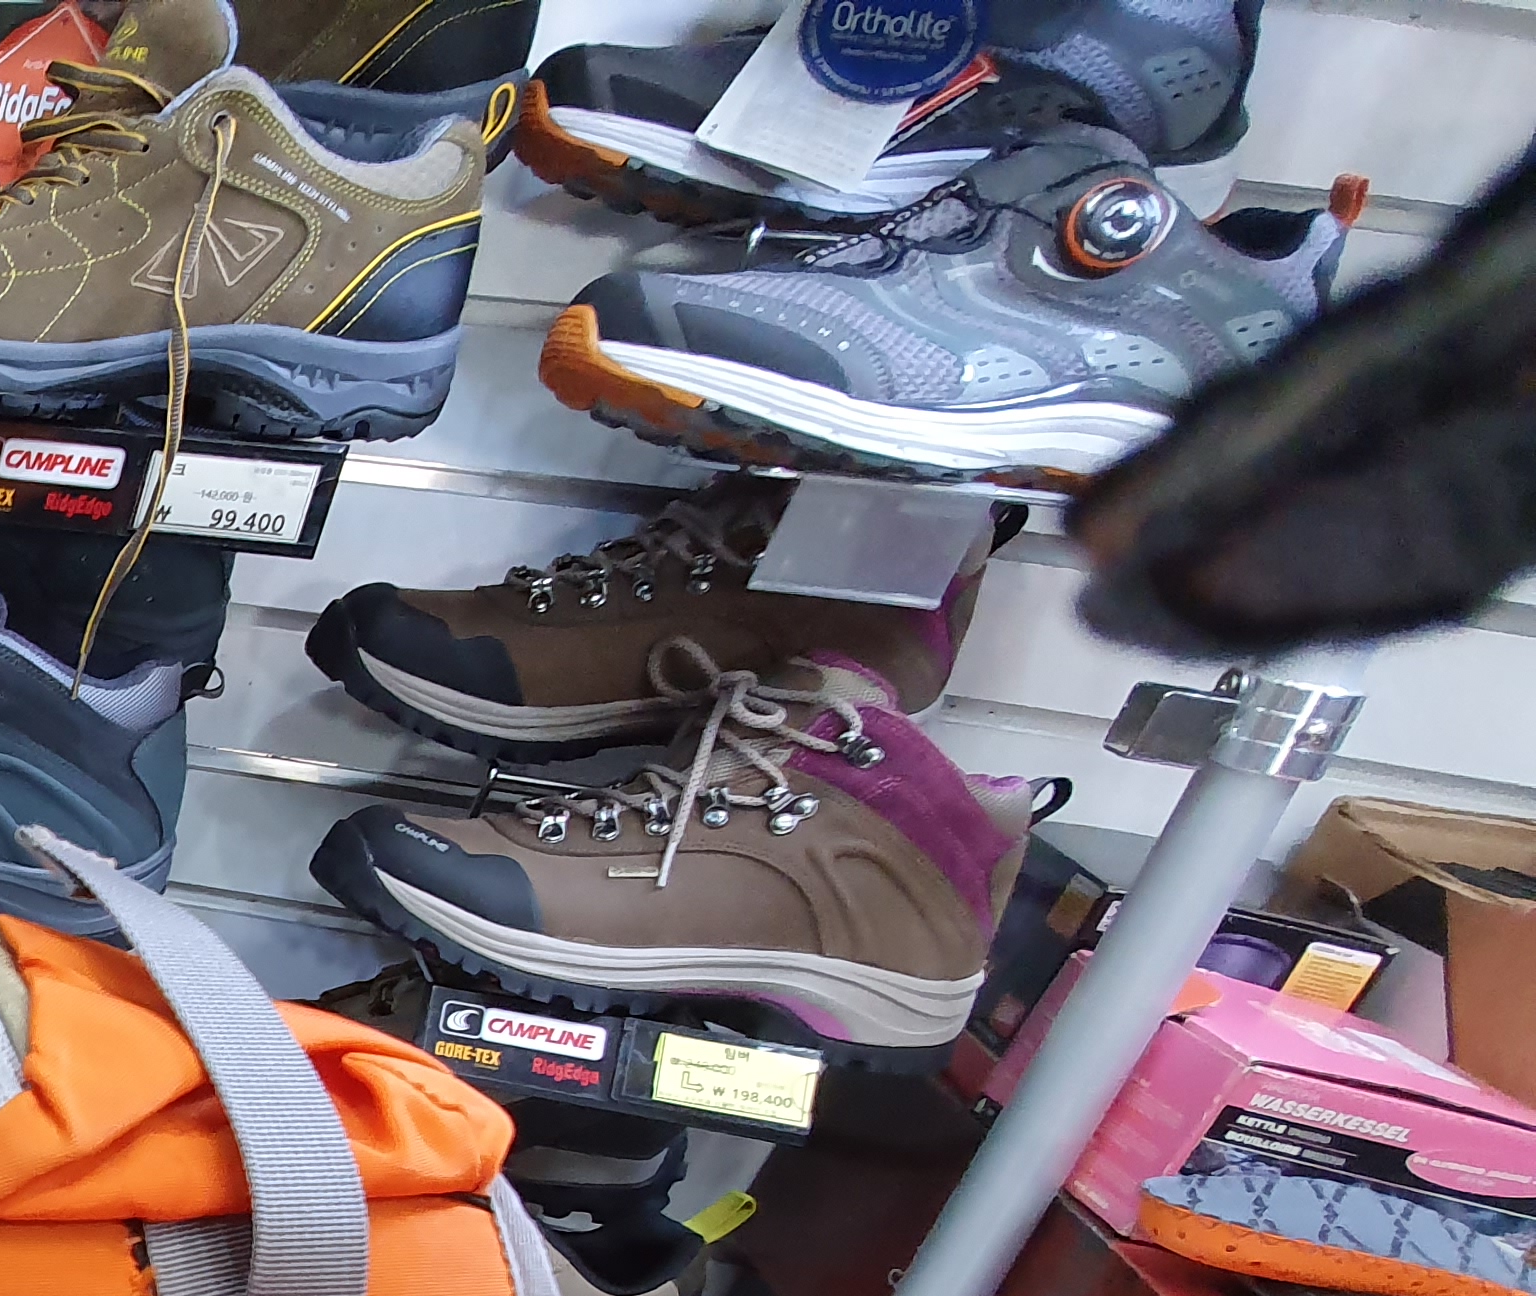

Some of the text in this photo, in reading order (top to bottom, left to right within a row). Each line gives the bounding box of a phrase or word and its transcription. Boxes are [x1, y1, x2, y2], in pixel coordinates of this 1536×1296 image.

[4, 449, 115, 478] CAMPLINE
[43, 491, 113, 521] RidgEdge
[209, 508, 286, 534] 99,400
[488, 1017, 596, 1050] CAMPLINE
[434, 1040, 601, 1086] GORE-TEX RidgEdge
[732, 1088, 793, 1108] 198,400
[1249, 1092, 1412, 1143] WASSERKESSEL
